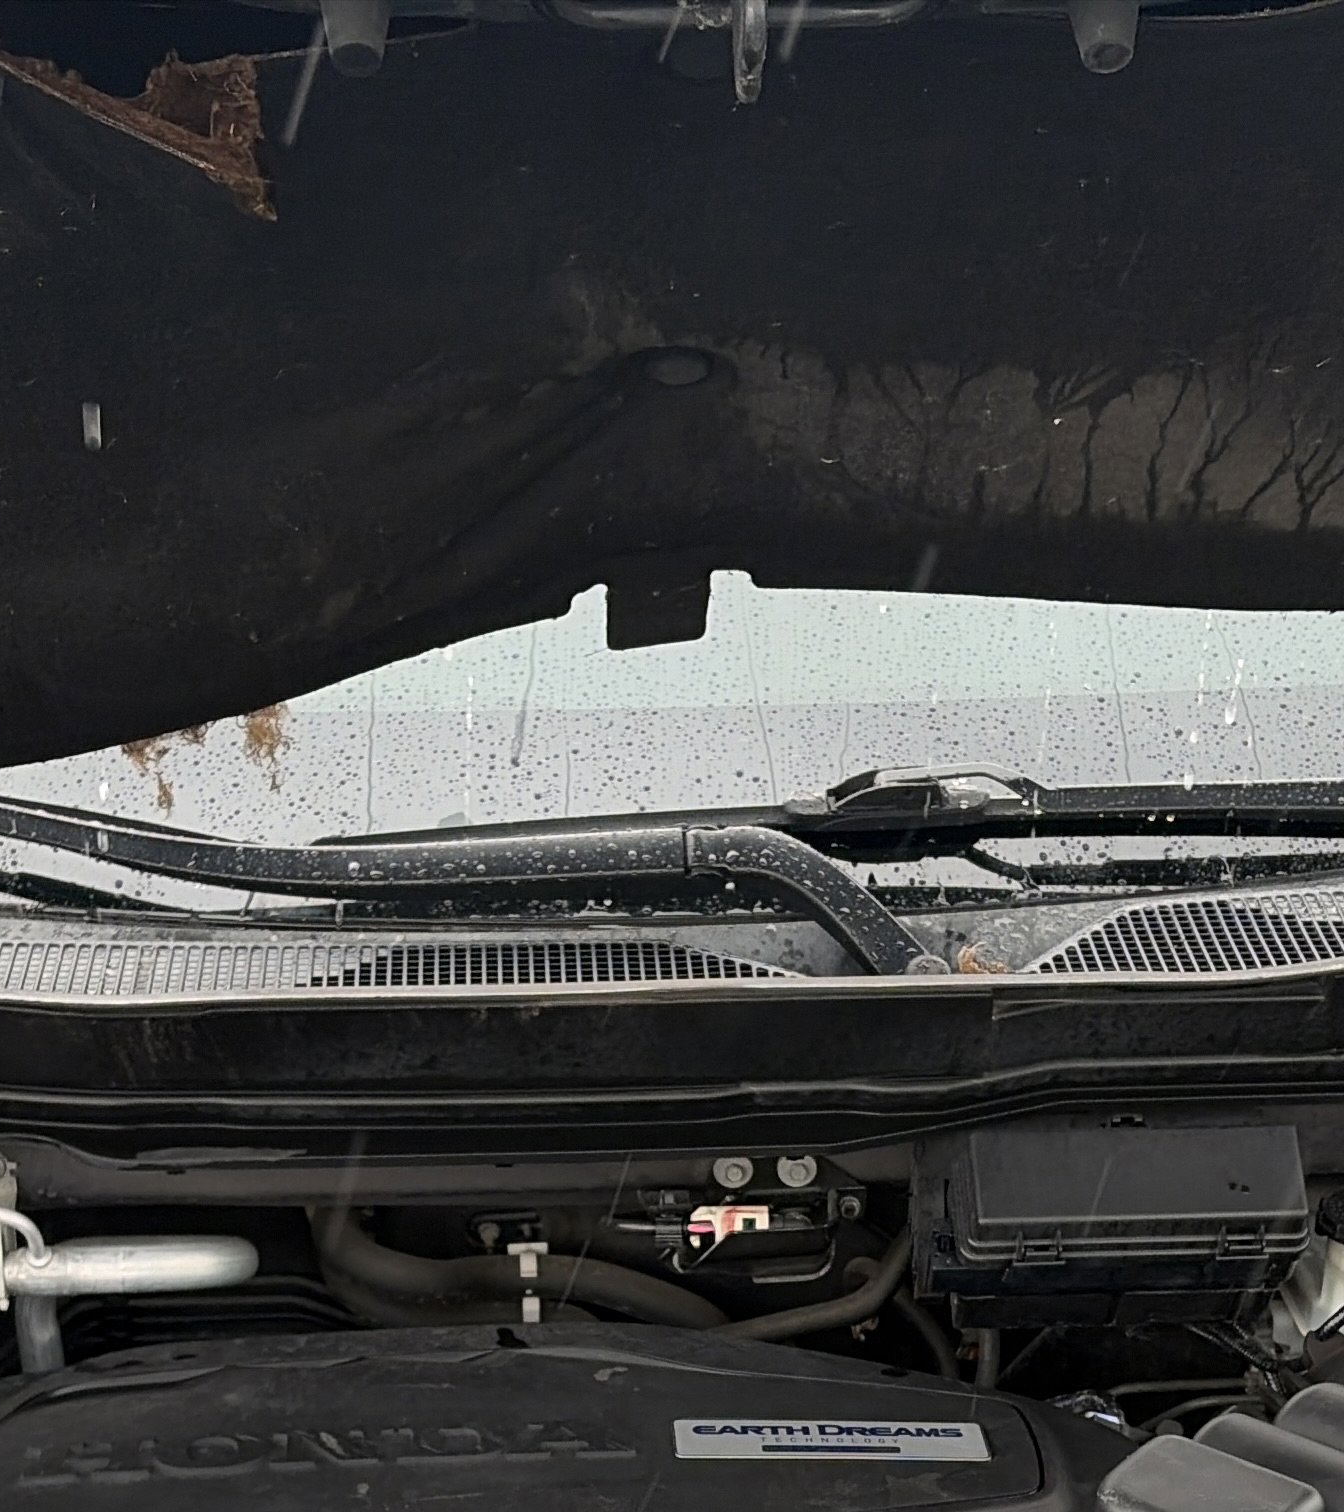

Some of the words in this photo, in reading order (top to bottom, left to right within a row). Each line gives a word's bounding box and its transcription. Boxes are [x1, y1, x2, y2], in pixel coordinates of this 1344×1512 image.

[692, 1425, 811, 1436] EARTH
[817, 1424, 964, 1438] DREAMS
[761, 1437, 899, 1445] TECHNOLOGY
